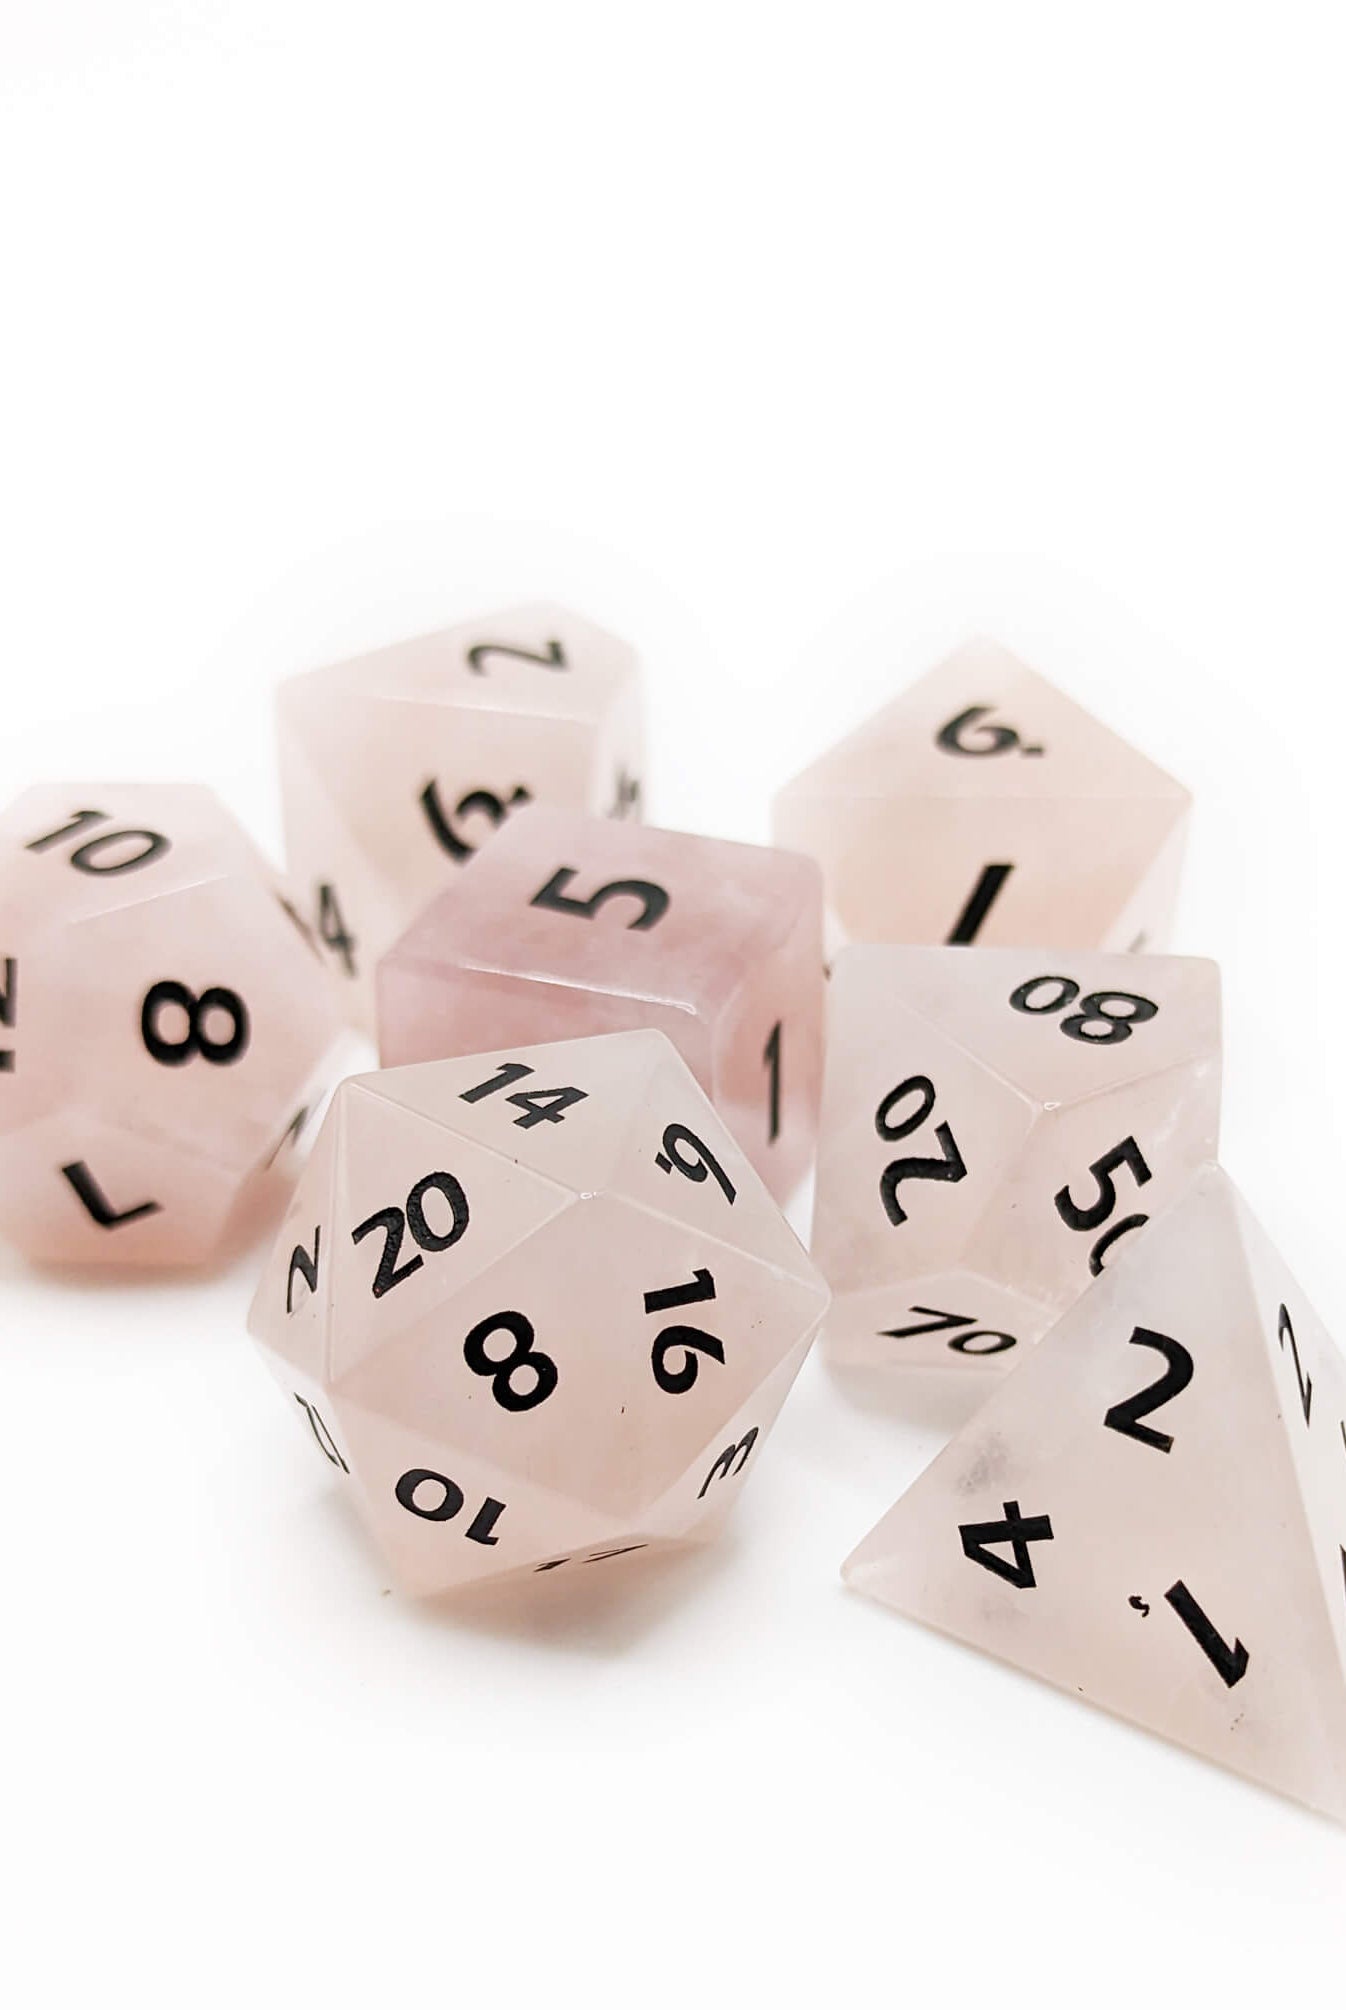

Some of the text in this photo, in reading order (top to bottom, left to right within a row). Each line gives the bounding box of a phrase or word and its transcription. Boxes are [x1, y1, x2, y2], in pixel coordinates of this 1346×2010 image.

[467, 641, 566, 673] 2
[25, 810, 169, 877] 10
[528, 866, 671, 932] 5
[137, 979, 251, 1068] 8
[1008, 975, 1159, 1046] 80
[457, 1062, 590, 1130] 14
[761, 1018, 784, 1145] 1
[874, 1074, 968, 1227] 20
[58, 1159, 166, 1235] 7
[350, 1170, 470, 1300] 20
[286, 1224, 321, 1314] 2
[462, 1310, 559, 1413] 8
[642, 1267, 726, 1395] 16
[876, 1305, 1018, 1357] 70
[1278, 1303, 1313, 1428] 2
[1103, 1325, 1195, 1455] 2
[394, 1468, 507, 1546] 10
[696, 1426, 760, 1500] 3
[957, 1500, 1055, 1590] 4
[1163, 1579, 1250, 1689] 1
